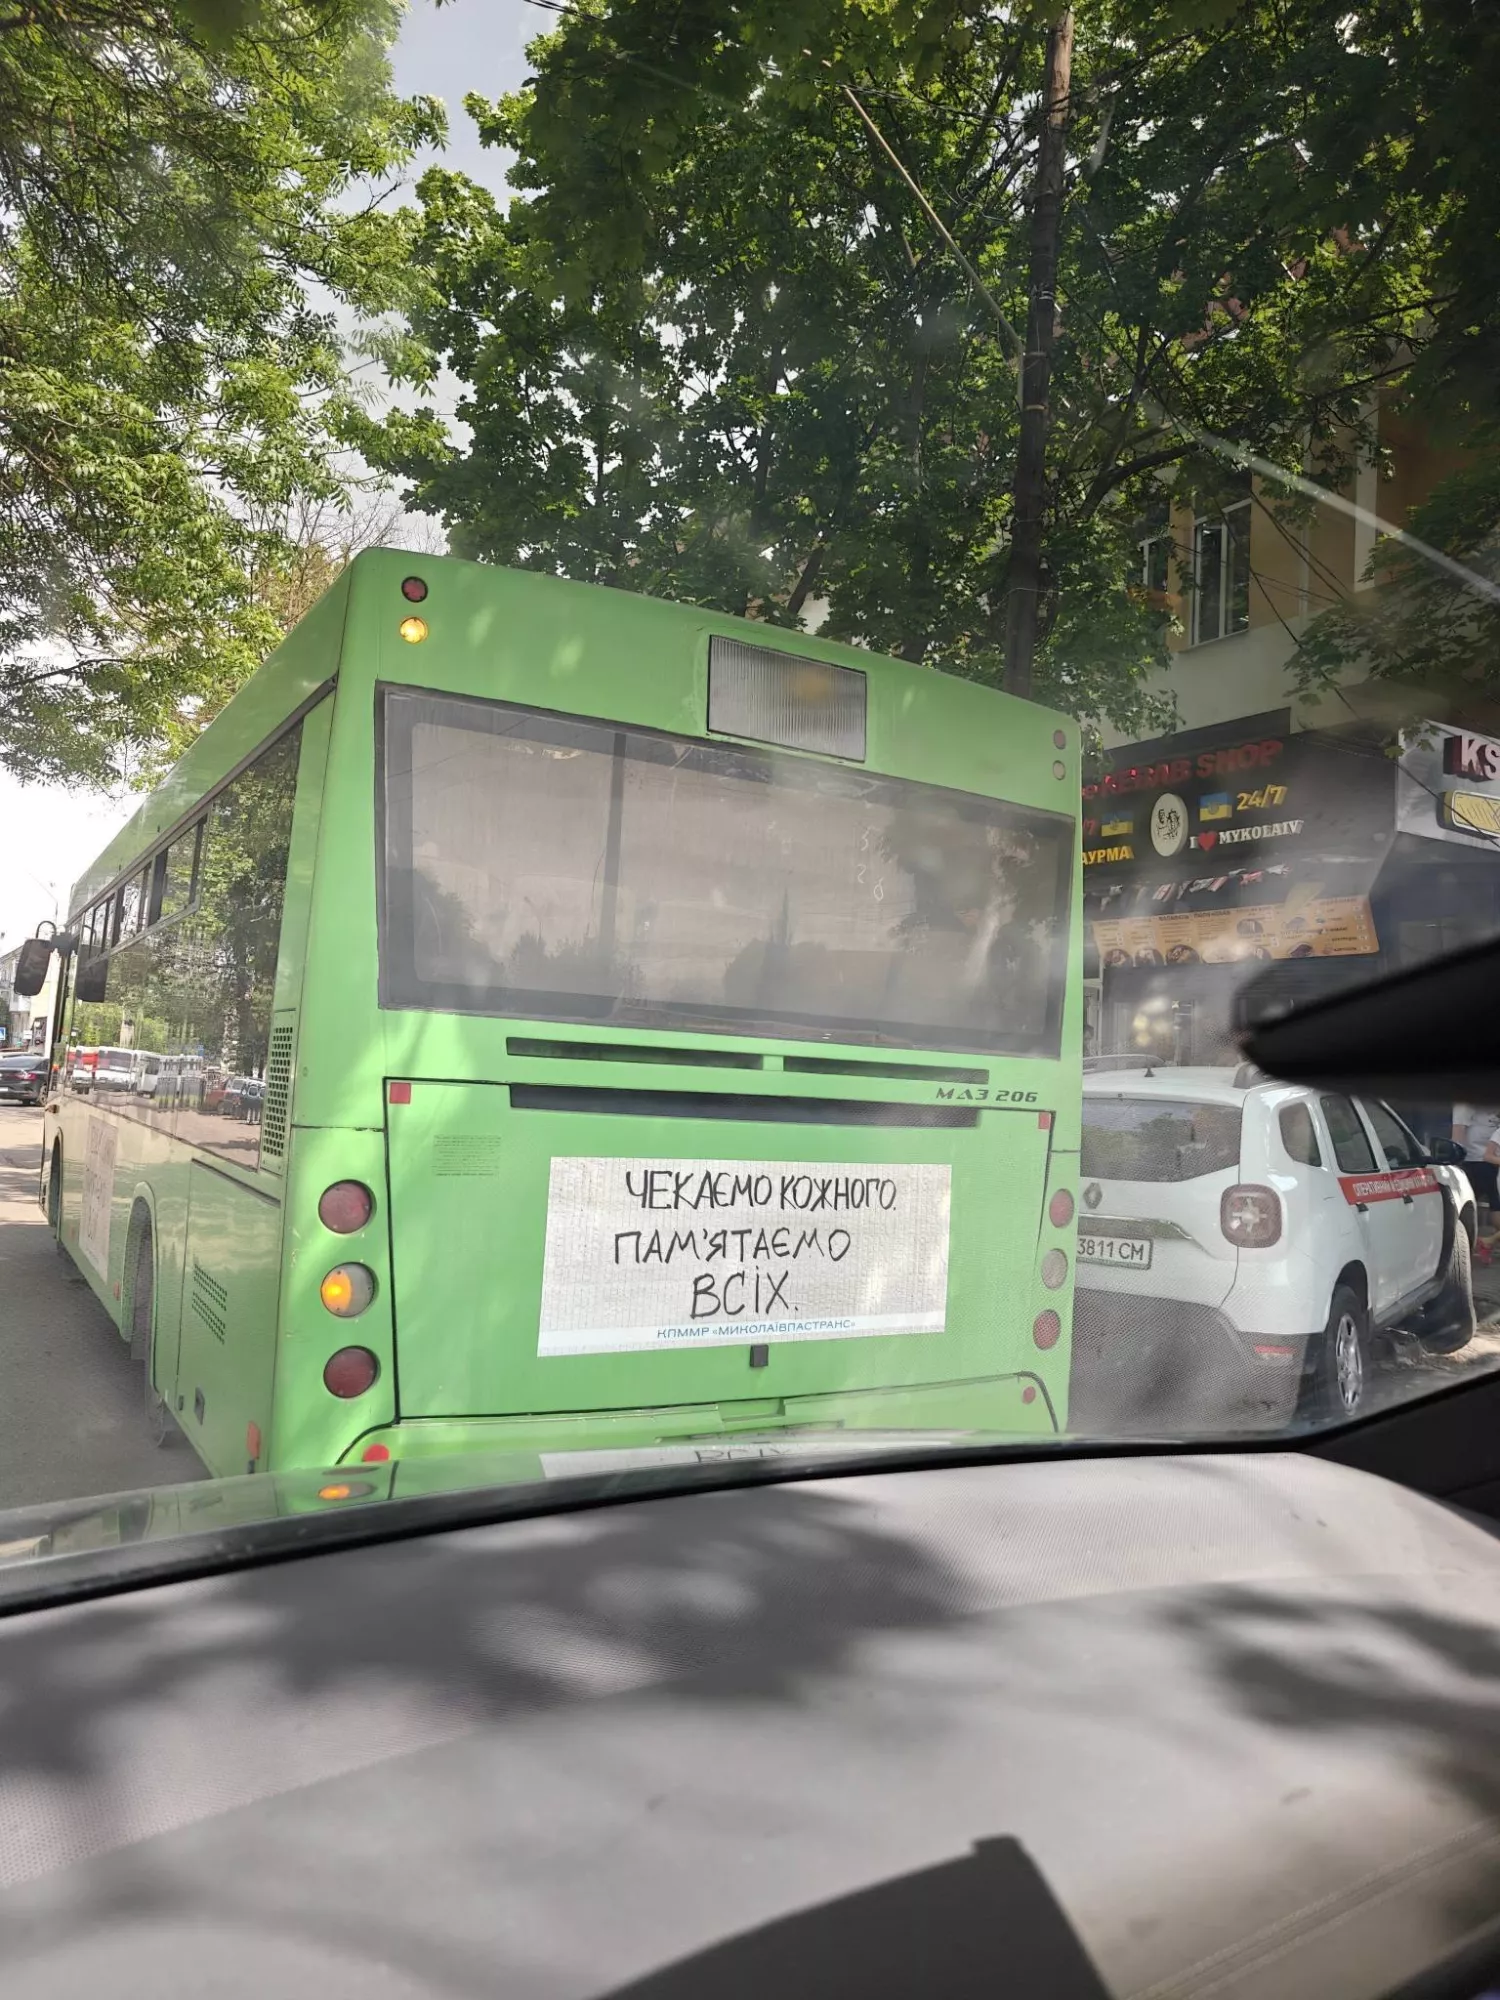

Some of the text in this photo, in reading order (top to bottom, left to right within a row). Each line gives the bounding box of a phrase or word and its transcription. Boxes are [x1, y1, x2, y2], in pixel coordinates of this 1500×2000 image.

[1196, 739, 1285, 778] SHOP
[1237, 784, 1288, 811] 24/7
[936, 1087, 1039, 1103] МАЗ 206
[626, 1169, 898, 1212] ЧЕКАЄМО КОЖНОГО.
[614, 1226, 851, 1265] ПАМ'ЯТАЄМО
[1077, 1238, 1144, 1261] 3811 CM
[690, 1265, 799, 1320] ВСІХ.
[657, 1326, 710, 1339] КПММР
